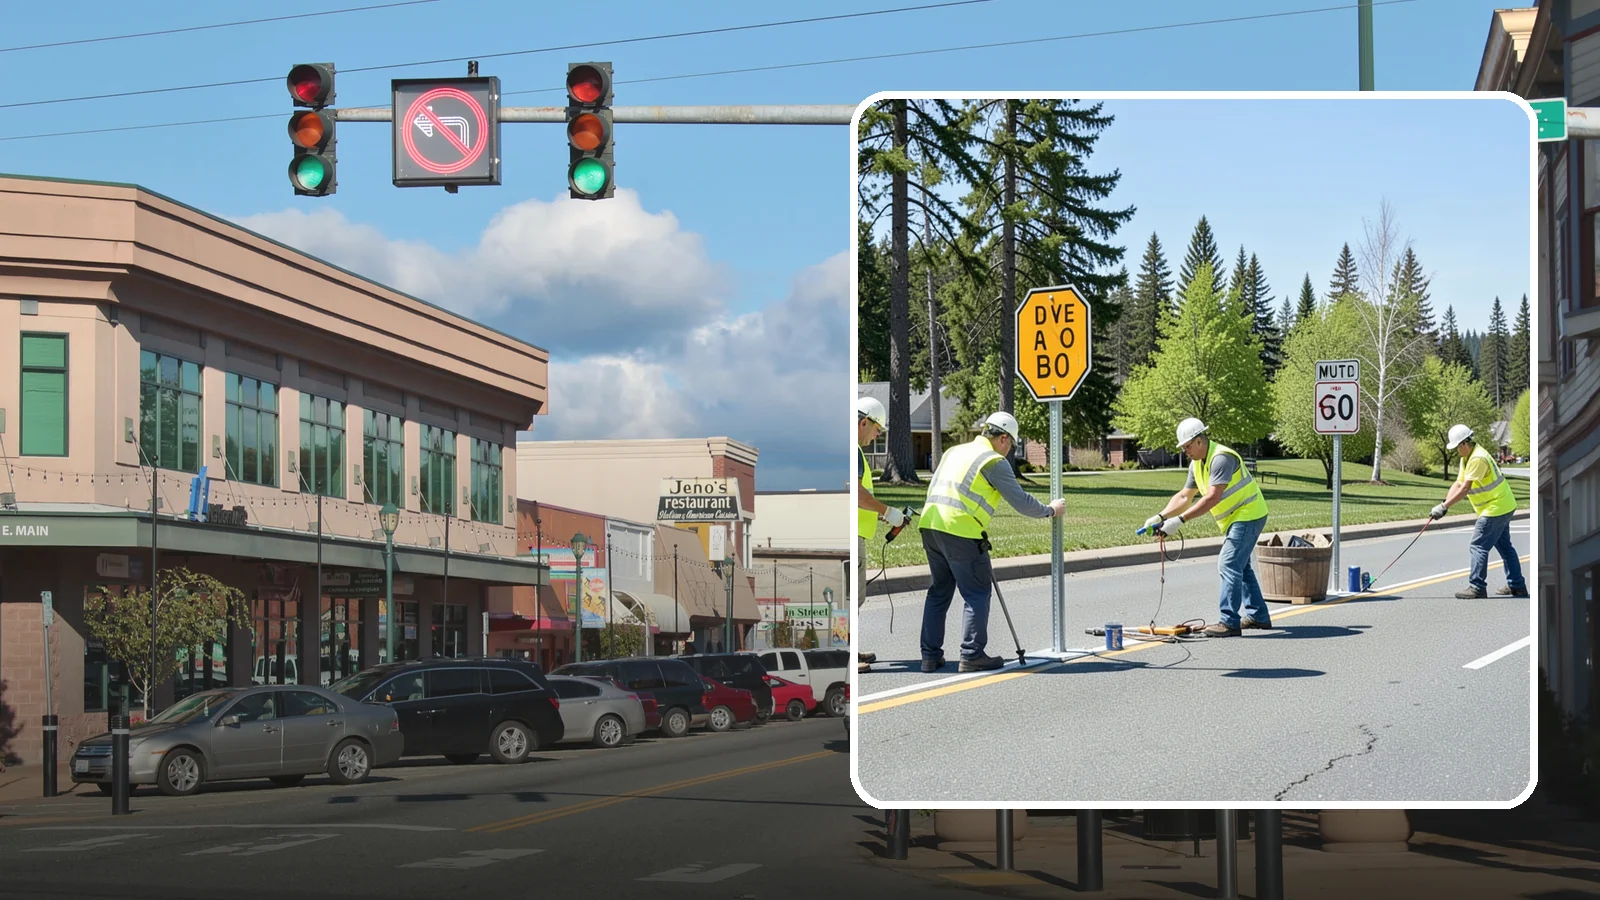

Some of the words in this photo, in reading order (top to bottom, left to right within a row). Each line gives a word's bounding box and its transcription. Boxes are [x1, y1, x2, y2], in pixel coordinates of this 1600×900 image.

[1034, 329, 1047, 351] A
[1037, 352, 1070, 379] BO
[1318, 393, 1354, 421] 60
[670, 480, 727, 494] Jeno's
[665, 496, 731, 508] restaurant
[659, 510, 681, 519] Italian
[686, 510, 714, 519] American
[715, 510, 737, 519] Cuisine
[2, 525, 13, 536] E.
[15, 525, 49, 536] MAIN
[797, 606, 828, 617] Street
